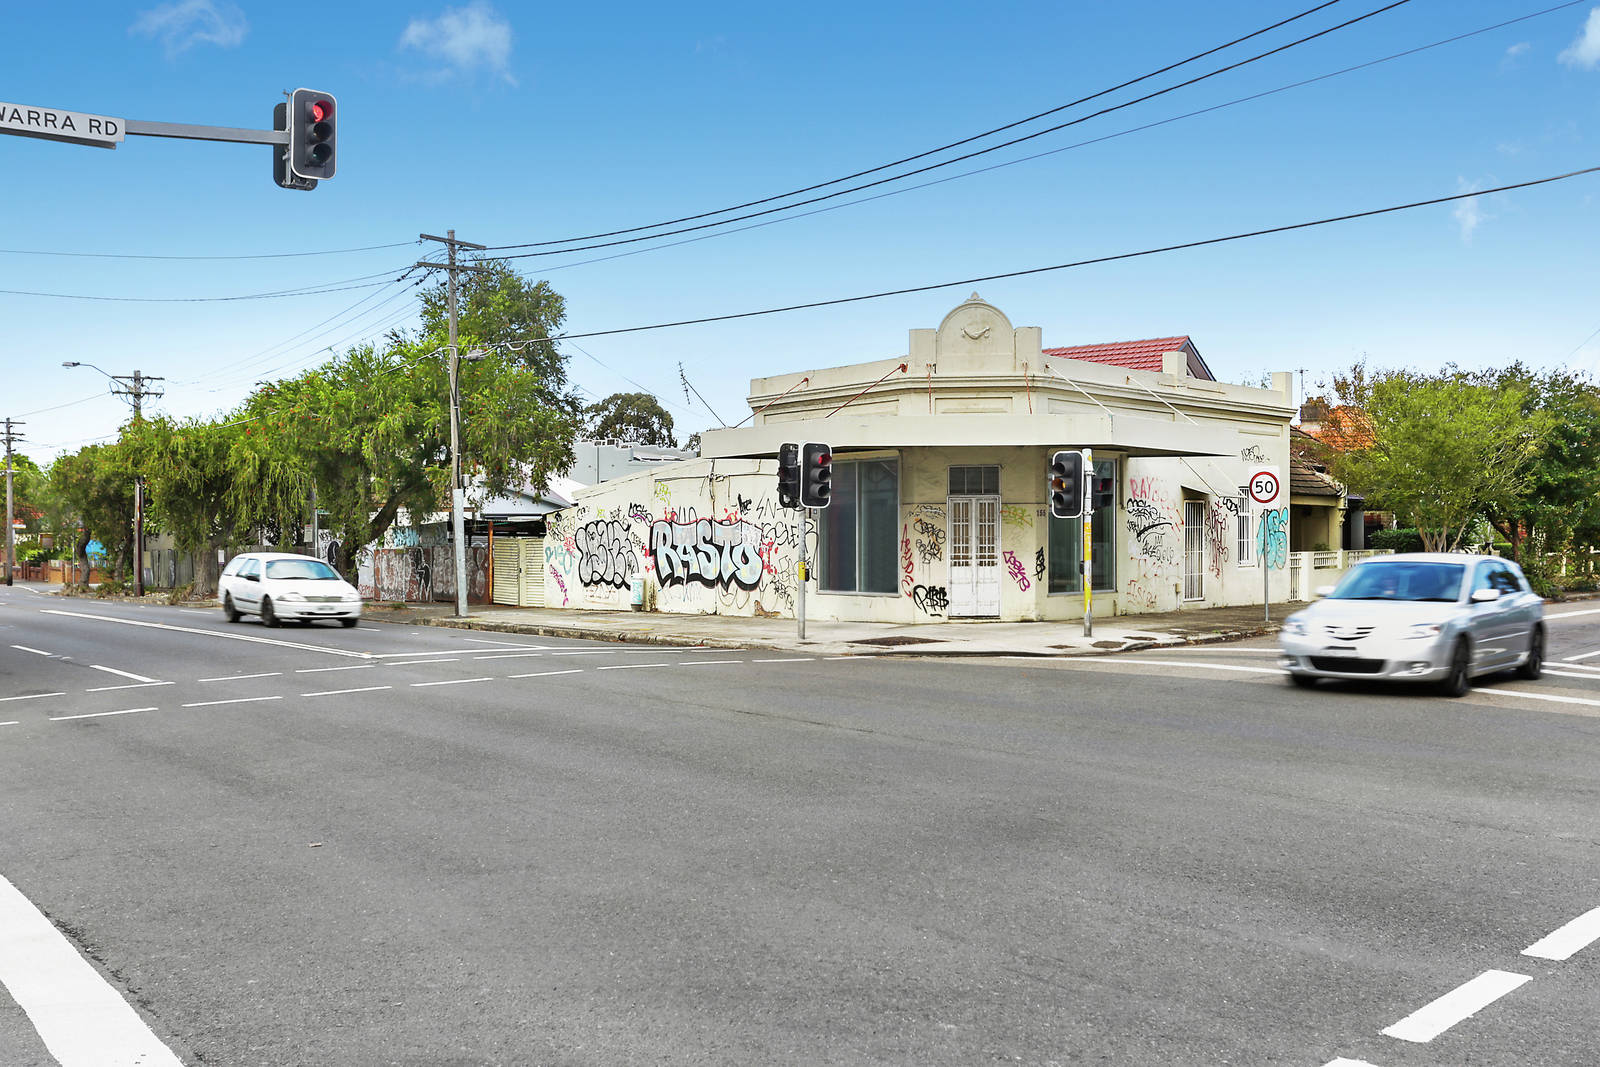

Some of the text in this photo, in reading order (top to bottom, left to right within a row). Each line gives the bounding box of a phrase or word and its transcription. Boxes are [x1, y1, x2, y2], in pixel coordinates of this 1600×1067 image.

[88, 118, 118, 136] RD
[1255, 481, 1274, 494] 50
[649, 518, 763, 594] RASTO
